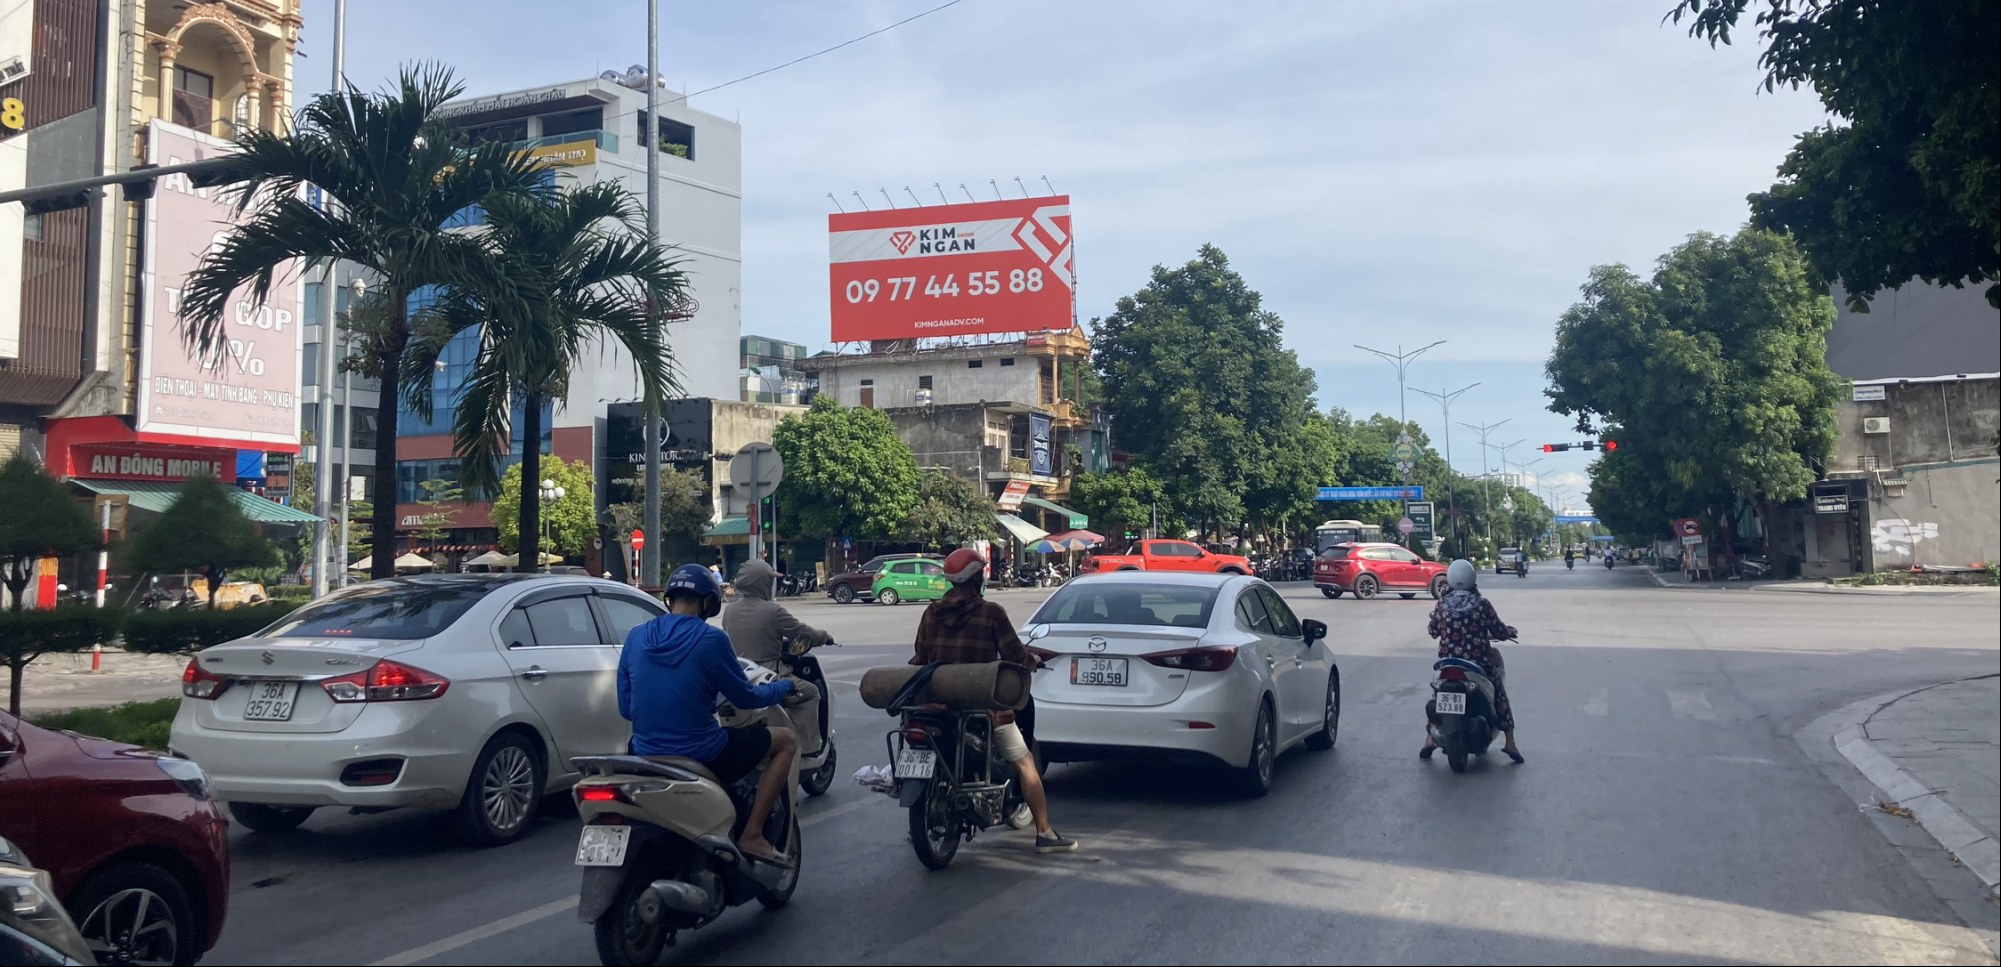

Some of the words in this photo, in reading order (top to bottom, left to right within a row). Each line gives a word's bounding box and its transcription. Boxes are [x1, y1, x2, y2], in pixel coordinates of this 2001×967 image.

[2, 97, 25, 129] 8
[920, 227, 956, 241] KIM
[920, 238, 975, 254] NGAN
[846, 279, 880, 304] 09
[887, 276, 917, 302] 77
[924, 273, 960, 299] 44
[968, 270, 1001, 296] 55
[1008, 267, 1044, 294] 88
[235, 300, 293, 332] GÓP
[914, 317, 985, 329] KIMNGANADV.COM
[91, 454, 117, 474] AN
[120, 452, 164, 476] ĐÔNG
[167, 459, 222, 478] MOBILE
[1091, 660, 1113, 671] 36A
[261, 682, 286, 699] 36A
[246, 700, 290, 718] 357.92
[904, 751, 931, 763] 36-BE
[899, 764, 931, 777] 001.16
